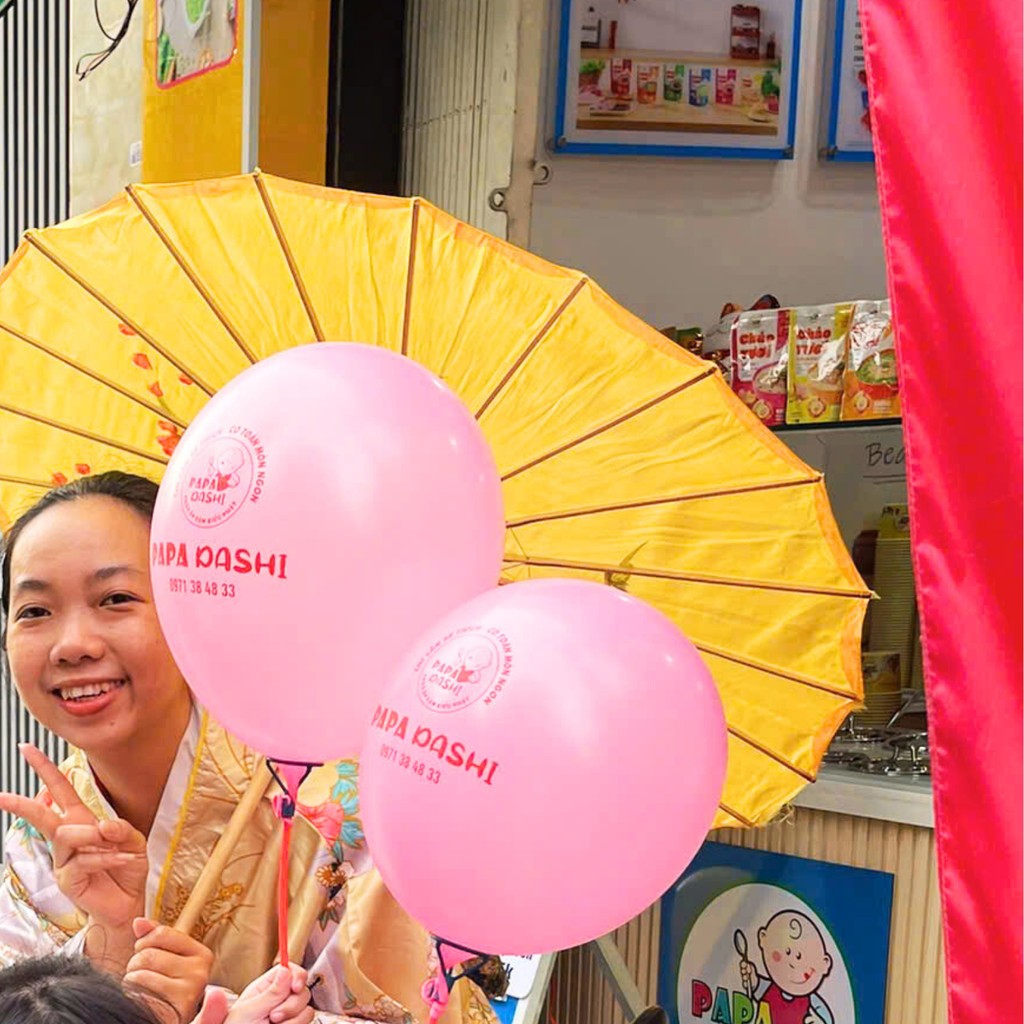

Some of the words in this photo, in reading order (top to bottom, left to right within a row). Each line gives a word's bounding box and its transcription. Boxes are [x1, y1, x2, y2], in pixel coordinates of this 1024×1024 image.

[195, 546, 288, 580] DASHI
[221, 583, 236, 598] 33
[412, 727, 499, 785] DASHI
[428, 766, 441, 785] 33
